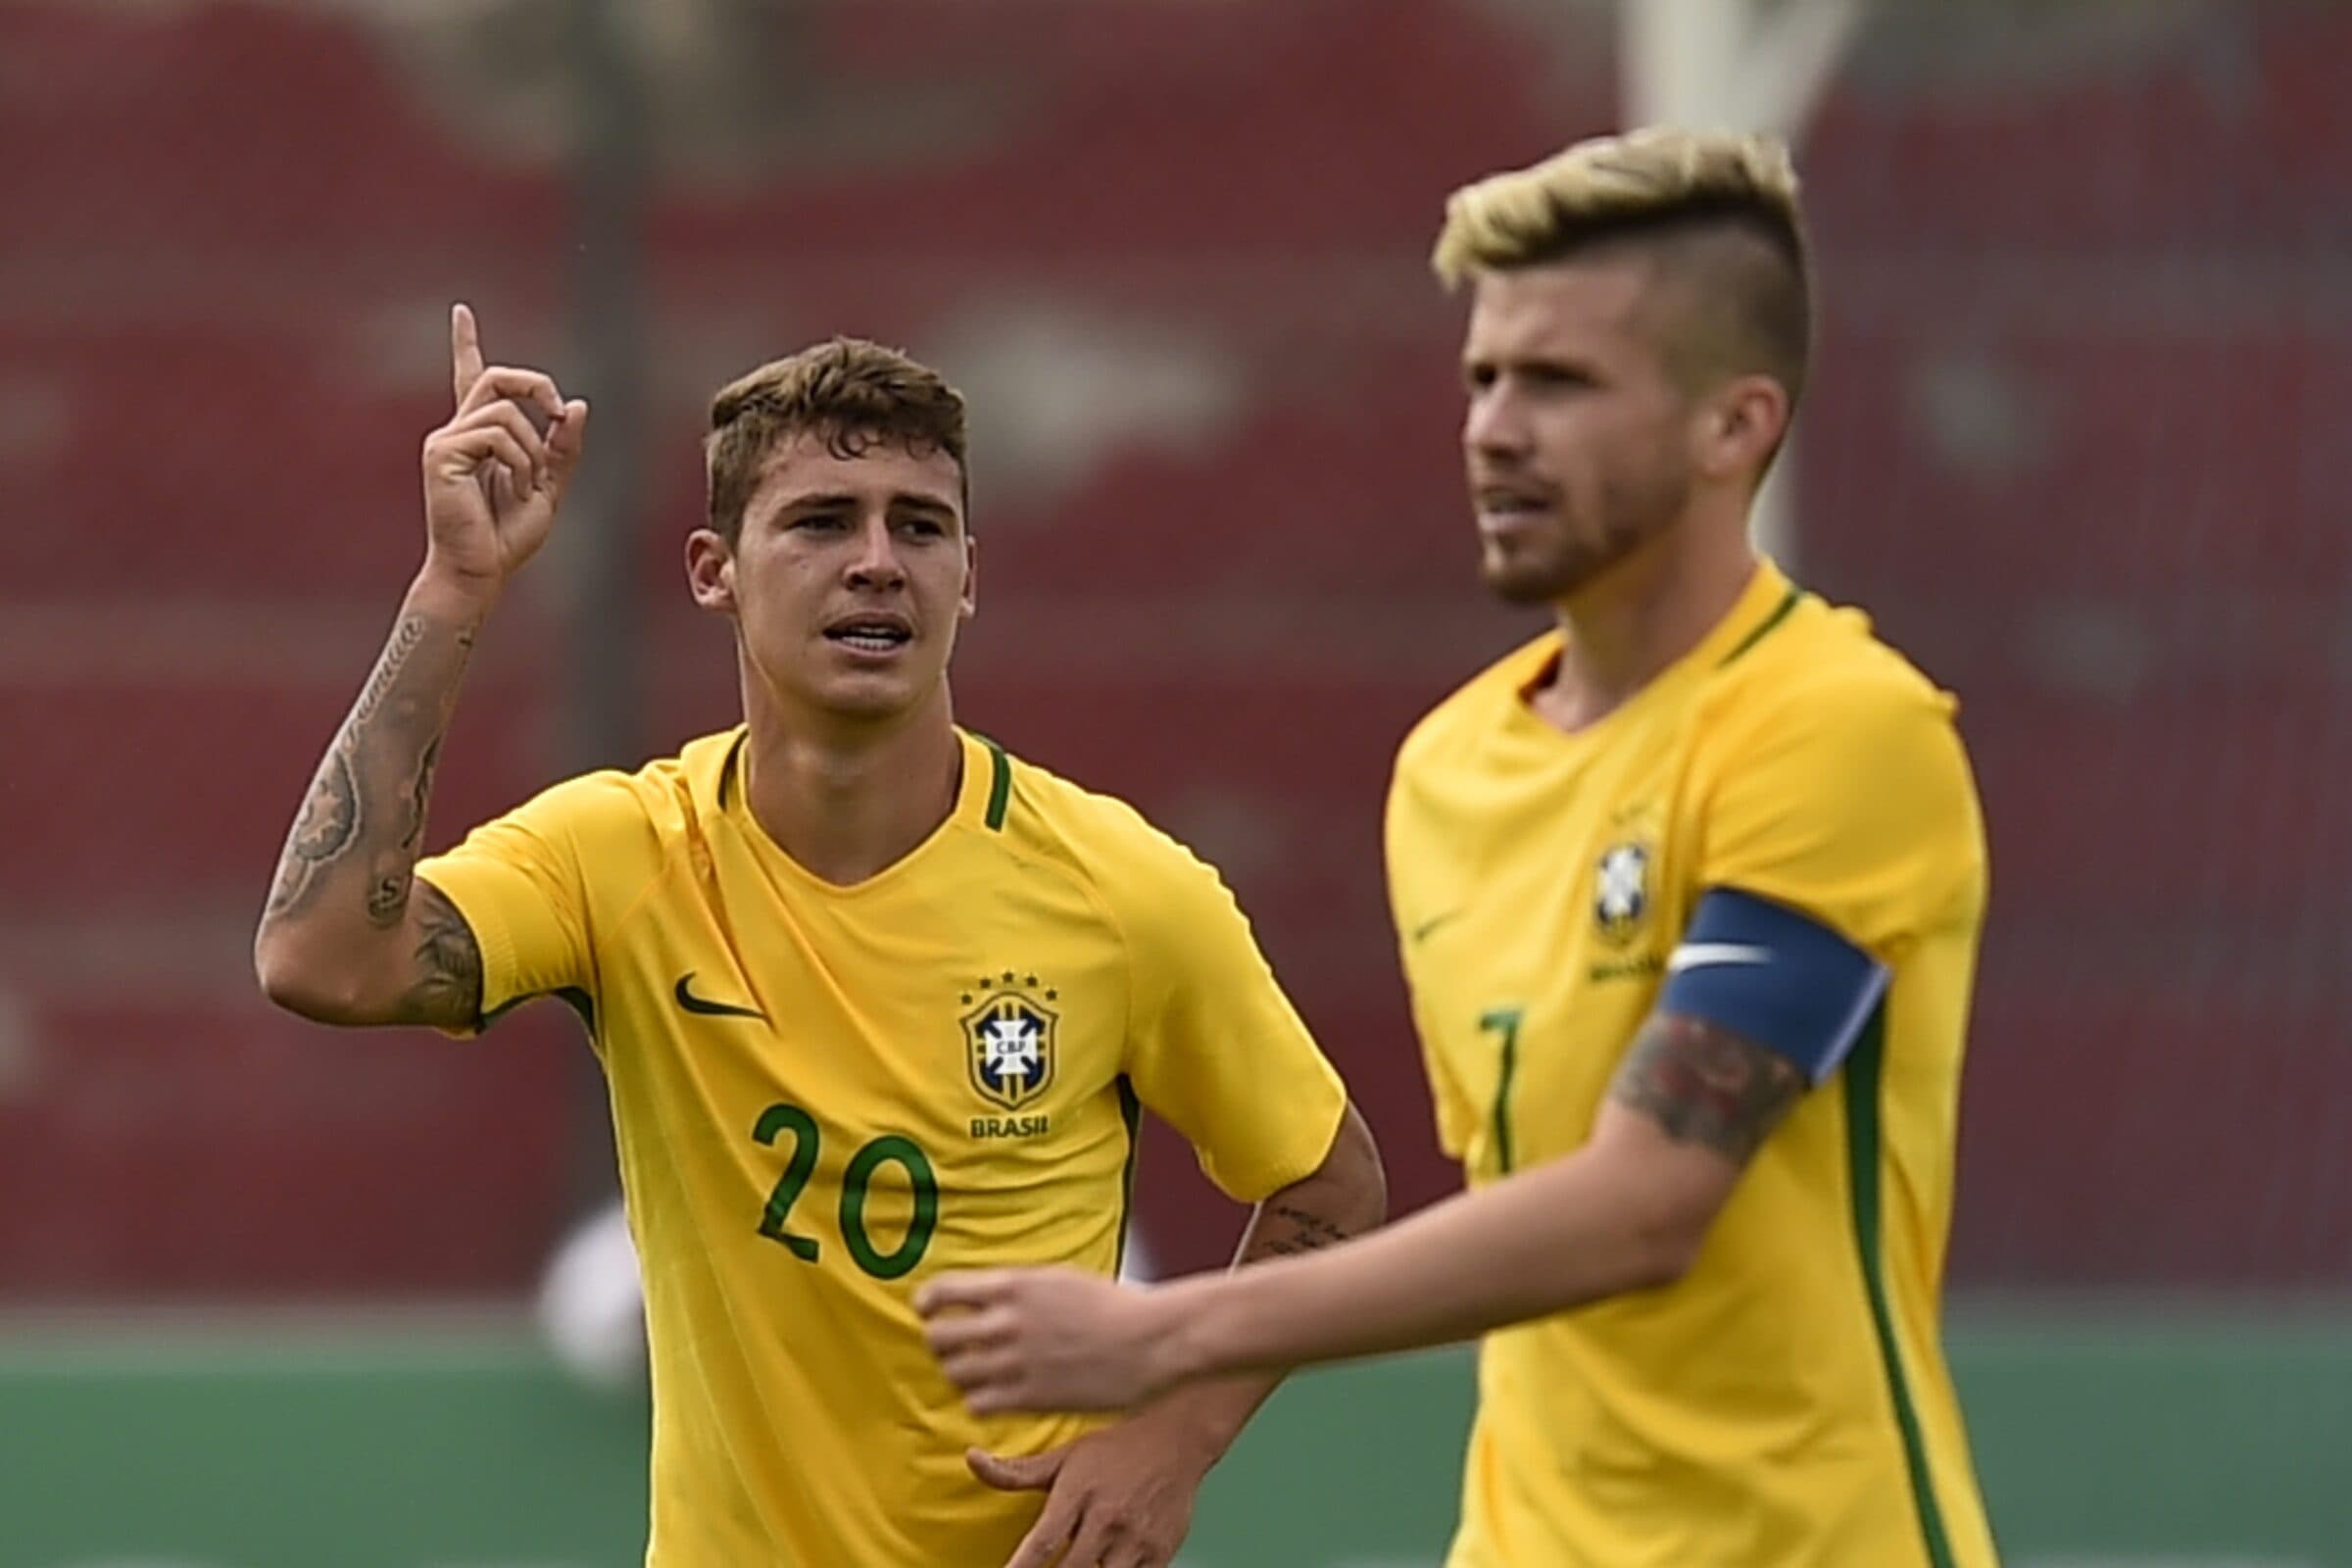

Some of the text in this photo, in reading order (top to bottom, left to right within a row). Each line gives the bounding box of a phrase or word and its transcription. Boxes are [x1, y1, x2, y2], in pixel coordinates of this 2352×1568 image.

[970, 1115, 1049, 1139] BRASIL
[1479, 1009, 1521, 1173] 7
[752, 1103, 938, 1280] 20
